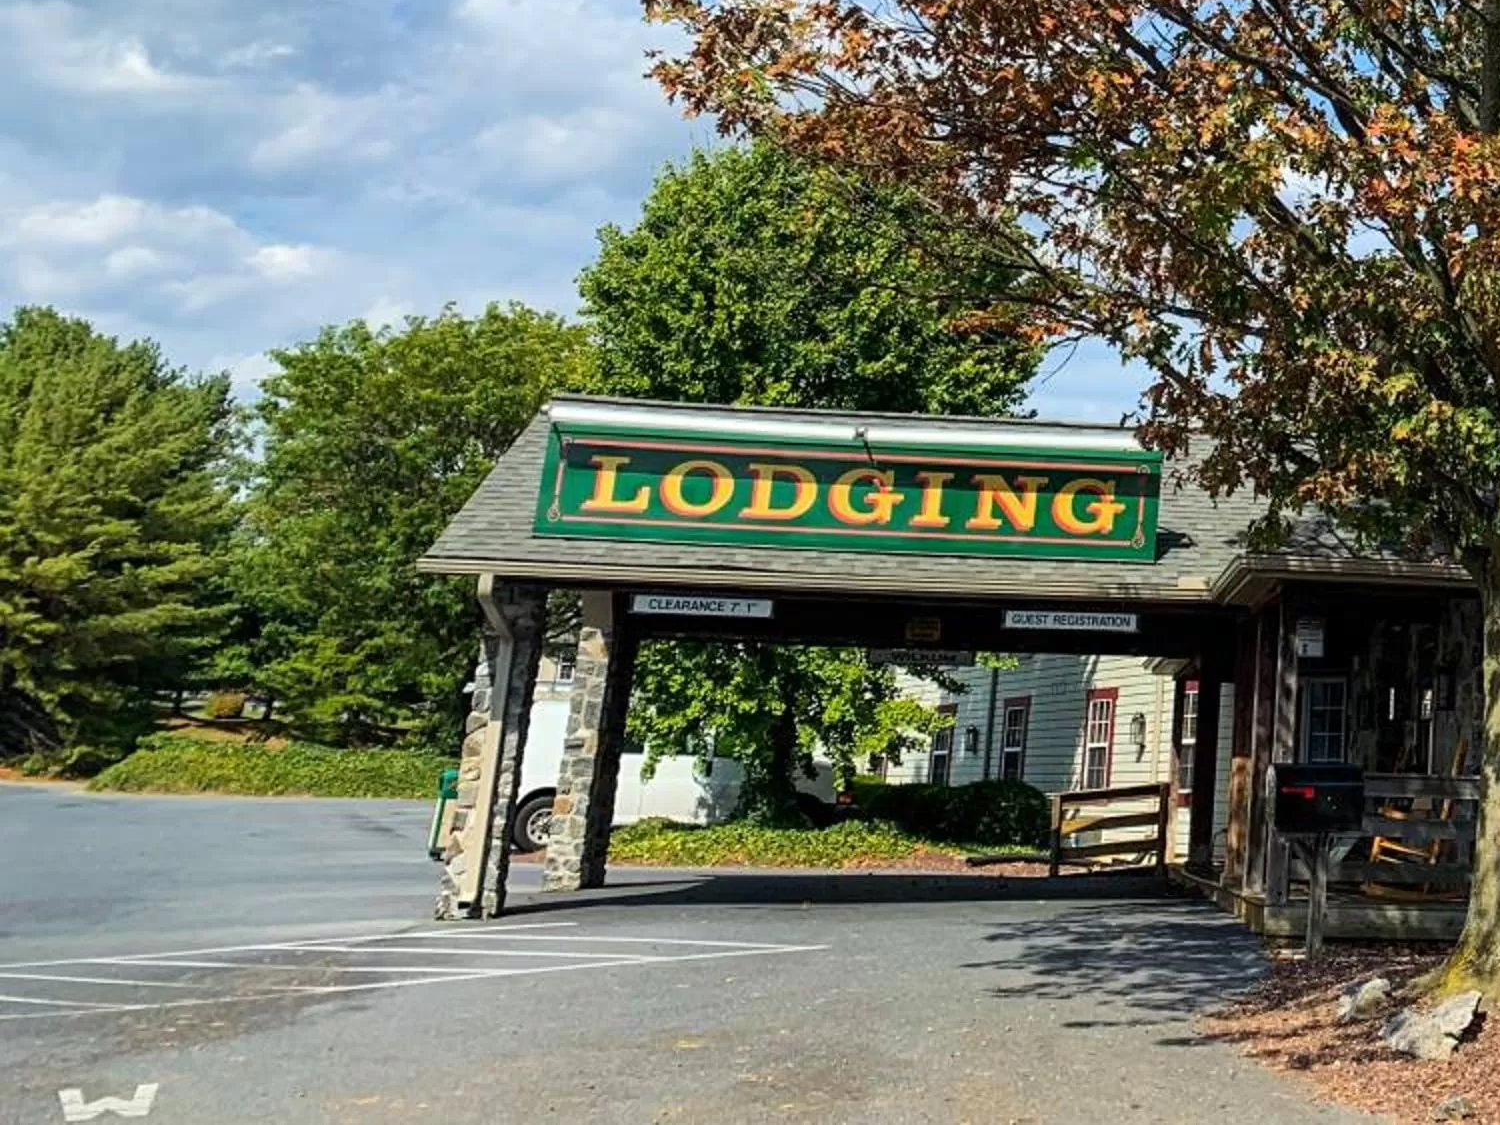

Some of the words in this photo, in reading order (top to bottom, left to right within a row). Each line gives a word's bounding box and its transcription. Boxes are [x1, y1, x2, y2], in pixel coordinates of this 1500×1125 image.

[580, 455, 1125, 534] LODGING
[648, 598, 725, 612] CLEARANCE
[1011, 613, 1049, 625] GUEST
[1052, 615, 1131, 627] REGISTRATION
